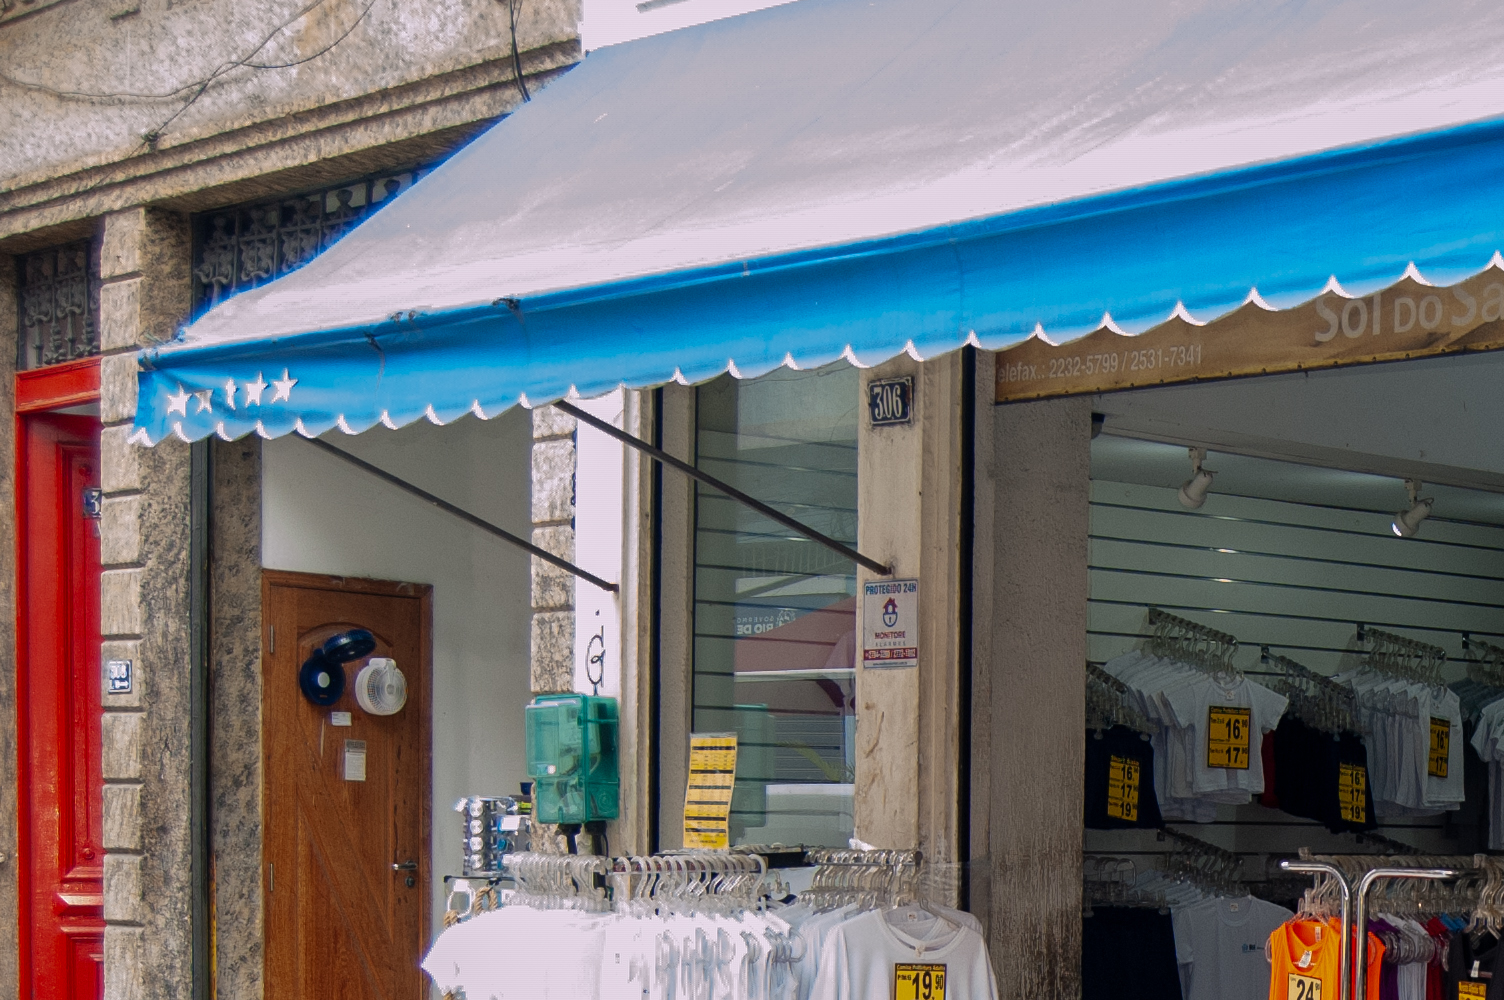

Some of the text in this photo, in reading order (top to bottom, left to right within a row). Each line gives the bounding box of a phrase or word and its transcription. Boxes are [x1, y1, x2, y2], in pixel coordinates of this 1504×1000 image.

[1315, 293, 1382, 342] Sol
[1050, 353, 1118, 378] 2232-5799
[1131, 344, 1202, 371] 2531-7341
[873, 385, 902, 420] 306
[866, 583, 917, 595] PROTEGIDO 24H
